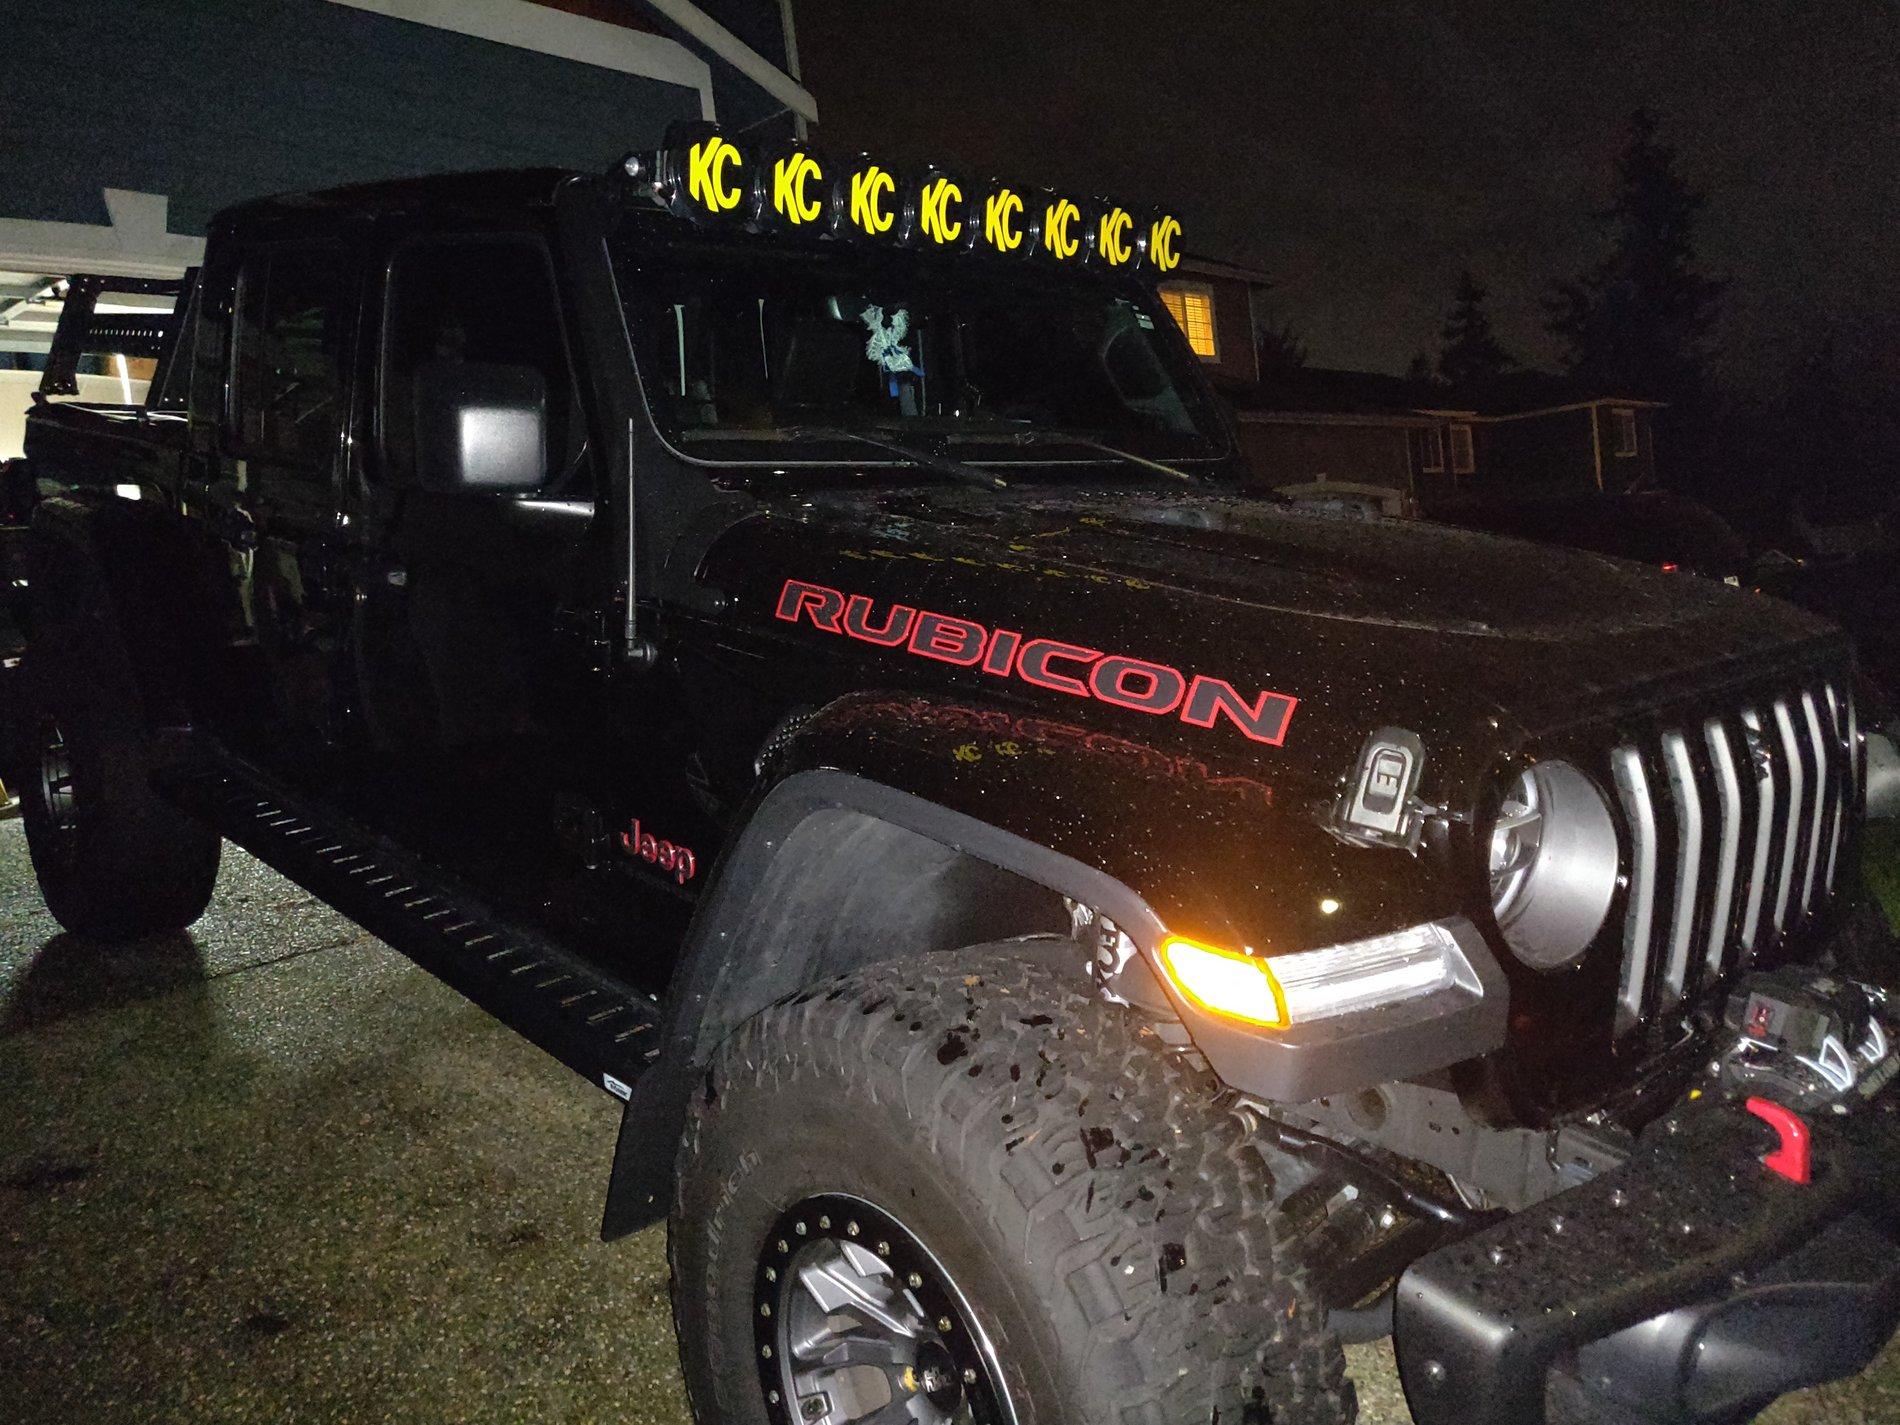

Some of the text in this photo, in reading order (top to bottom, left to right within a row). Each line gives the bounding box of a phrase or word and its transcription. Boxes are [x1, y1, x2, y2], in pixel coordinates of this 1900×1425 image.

[689, 137, 742, 212] KC
[774, 153, 822, 224] KC
[851, 166, 895, 234] KC
[921, 178, 962, 243] KC
[986, 189, 1023, 252] KC
[1045, 199, 1080, 259] KC
[1100, 208, 1132, 265] KC
[1151, 216, 1181, 271] KC
[776, 579, 1298, 747] RUBICON
[619, 817, 697, 886] Jeep
